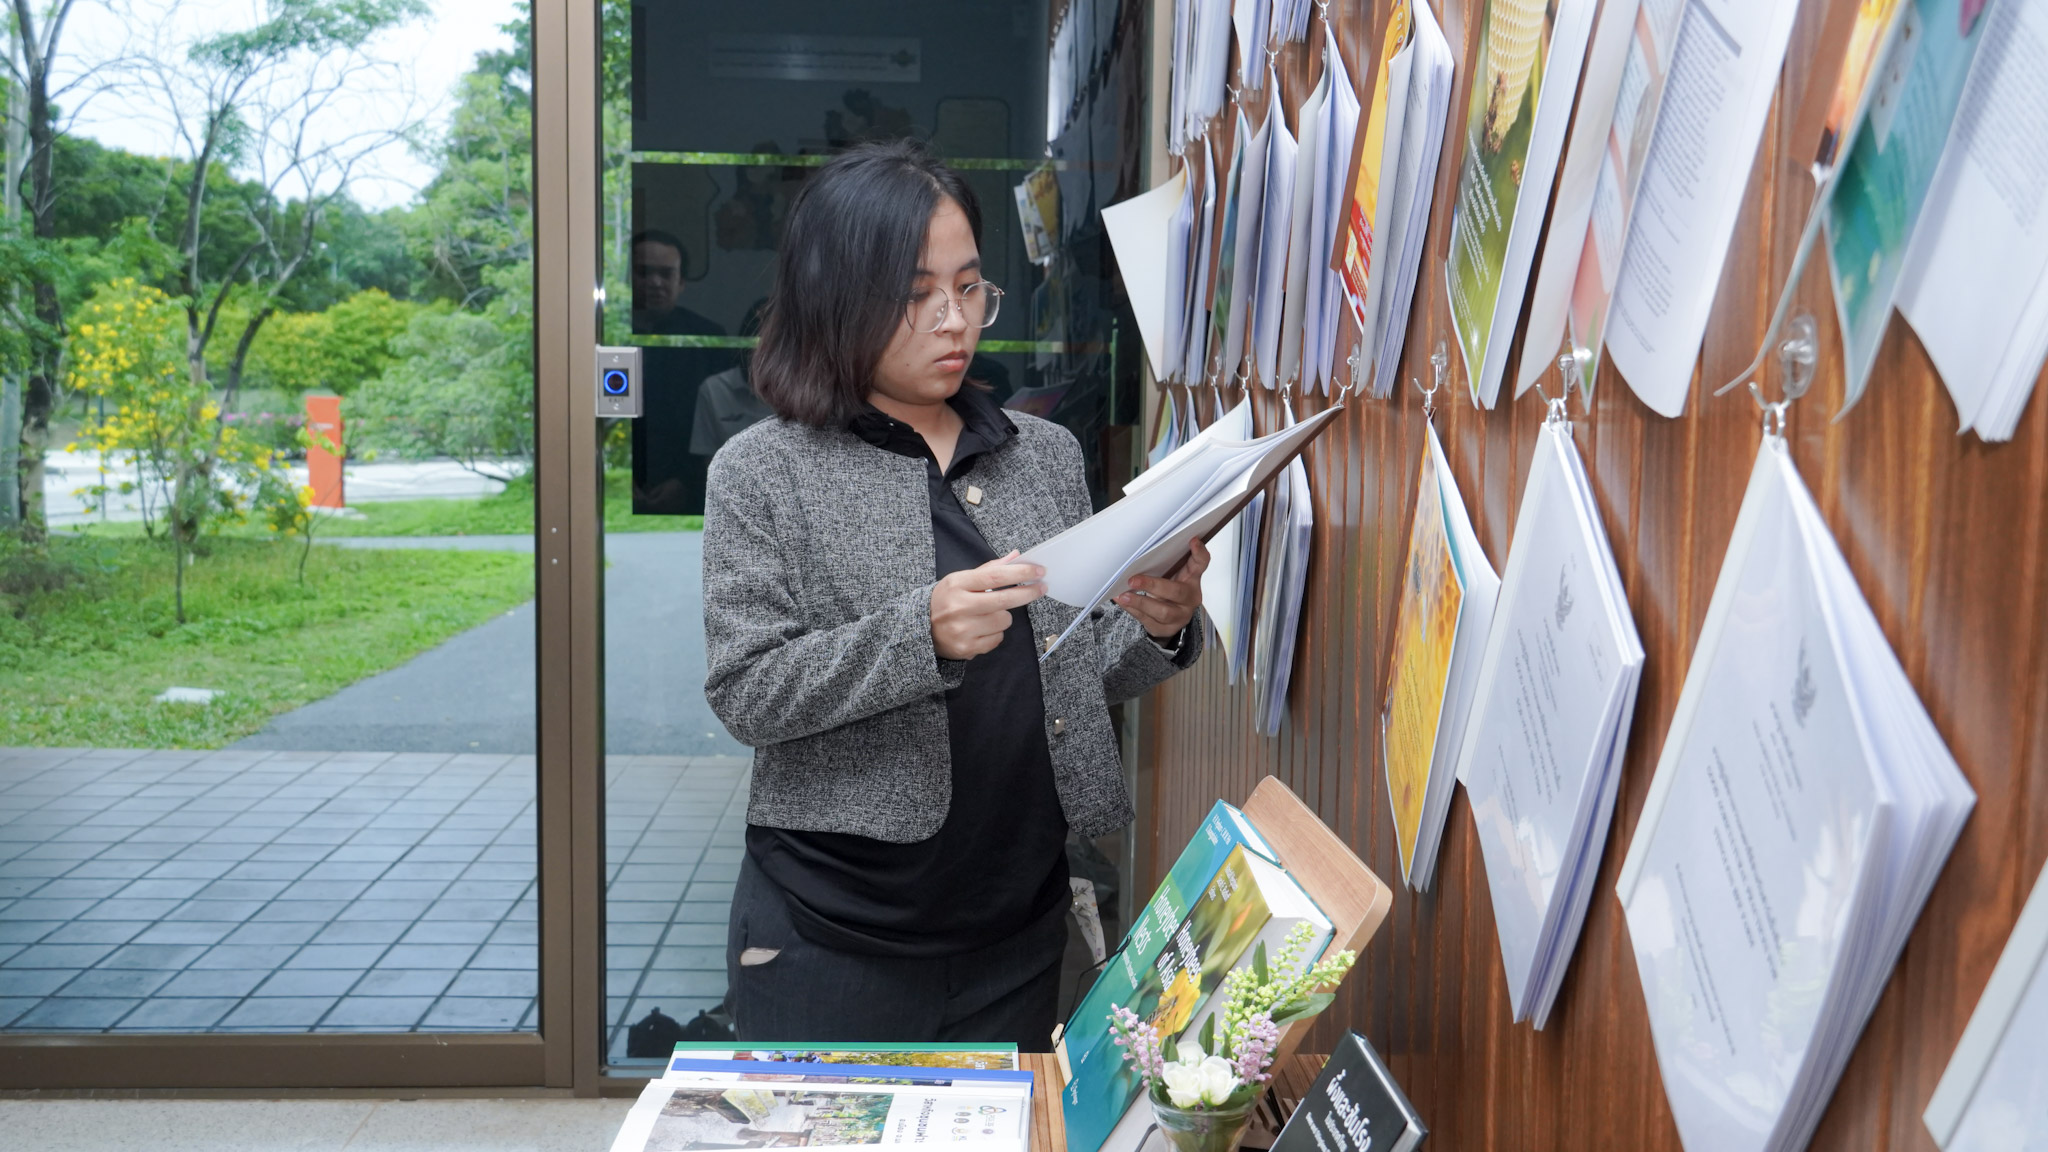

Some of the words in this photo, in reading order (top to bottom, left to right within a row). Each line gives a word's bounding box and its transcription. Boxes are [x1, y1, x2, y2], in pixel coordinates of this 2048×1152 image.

[1133, 915, 1151, 955] Nests
[1153, 884, 1180, 942] Honeybee
[1157, 952, 1174, 972] of
[1160, 958, 1178, 992] Asia
[1176, 919, 1202, 984] Honeybees
[1326, 1069, 1371, 1152] ผึ้งและชันโรง
